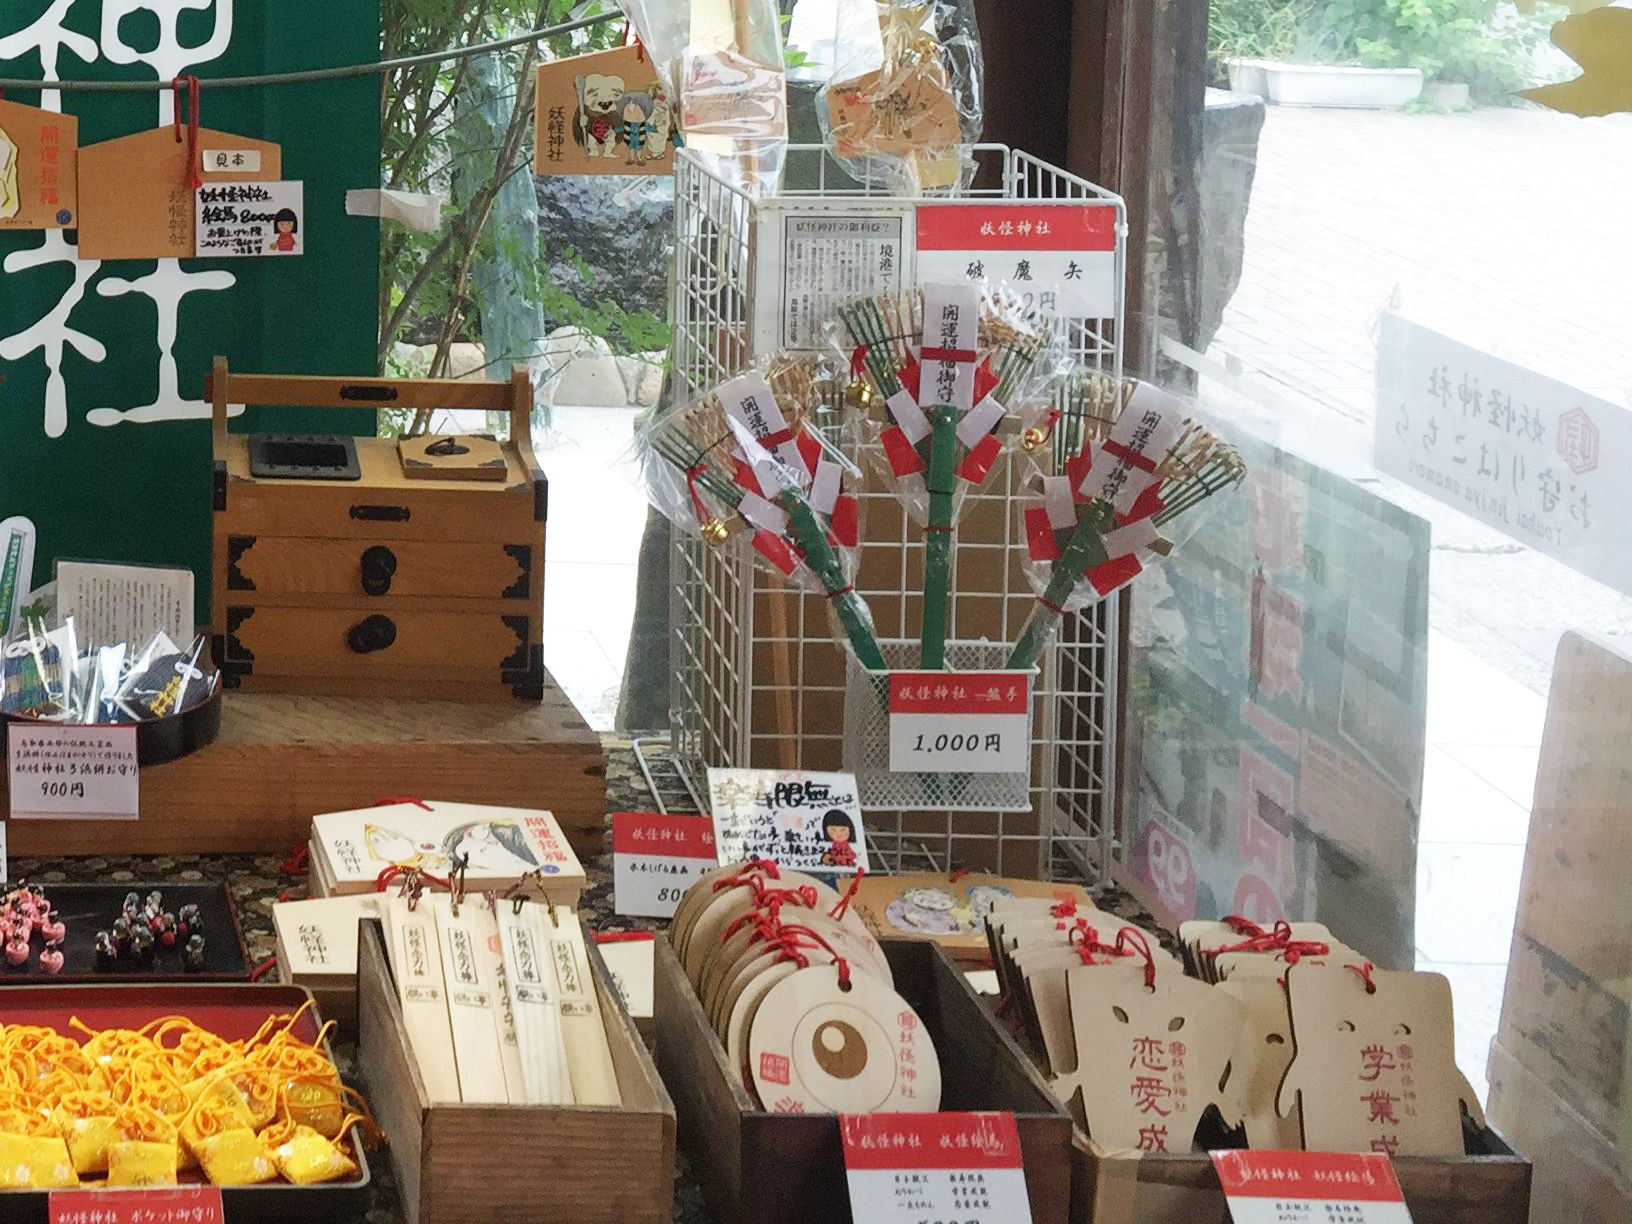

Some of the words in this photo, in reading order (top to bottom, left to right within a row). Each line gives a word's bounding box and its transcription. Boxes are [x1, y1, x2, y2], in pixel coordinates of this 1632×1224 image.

[547, 106, 566, 162] 妖怪神社
[40, 124, 60, 206] 開運招福
[216, 152, 245, 168] 見本
[198, 184, 273, 203] 妖怪神社
[202, 205, 239, 225] 絵馬
[979, 219, 1052, 236] 妖怪神社
[966, 259, 1084, 281] 破魔矢
[898, 685, 968, 701] 妖怪神社
[912, 733, 1001, 754] 1.000円
[41, 781, 85, 798] 900円
[524, 816, 568, 863] 開運招福
[632, 827, 688, 842] 妖怪神社
[131, 1206, 215, 1223] ポケット御守り
